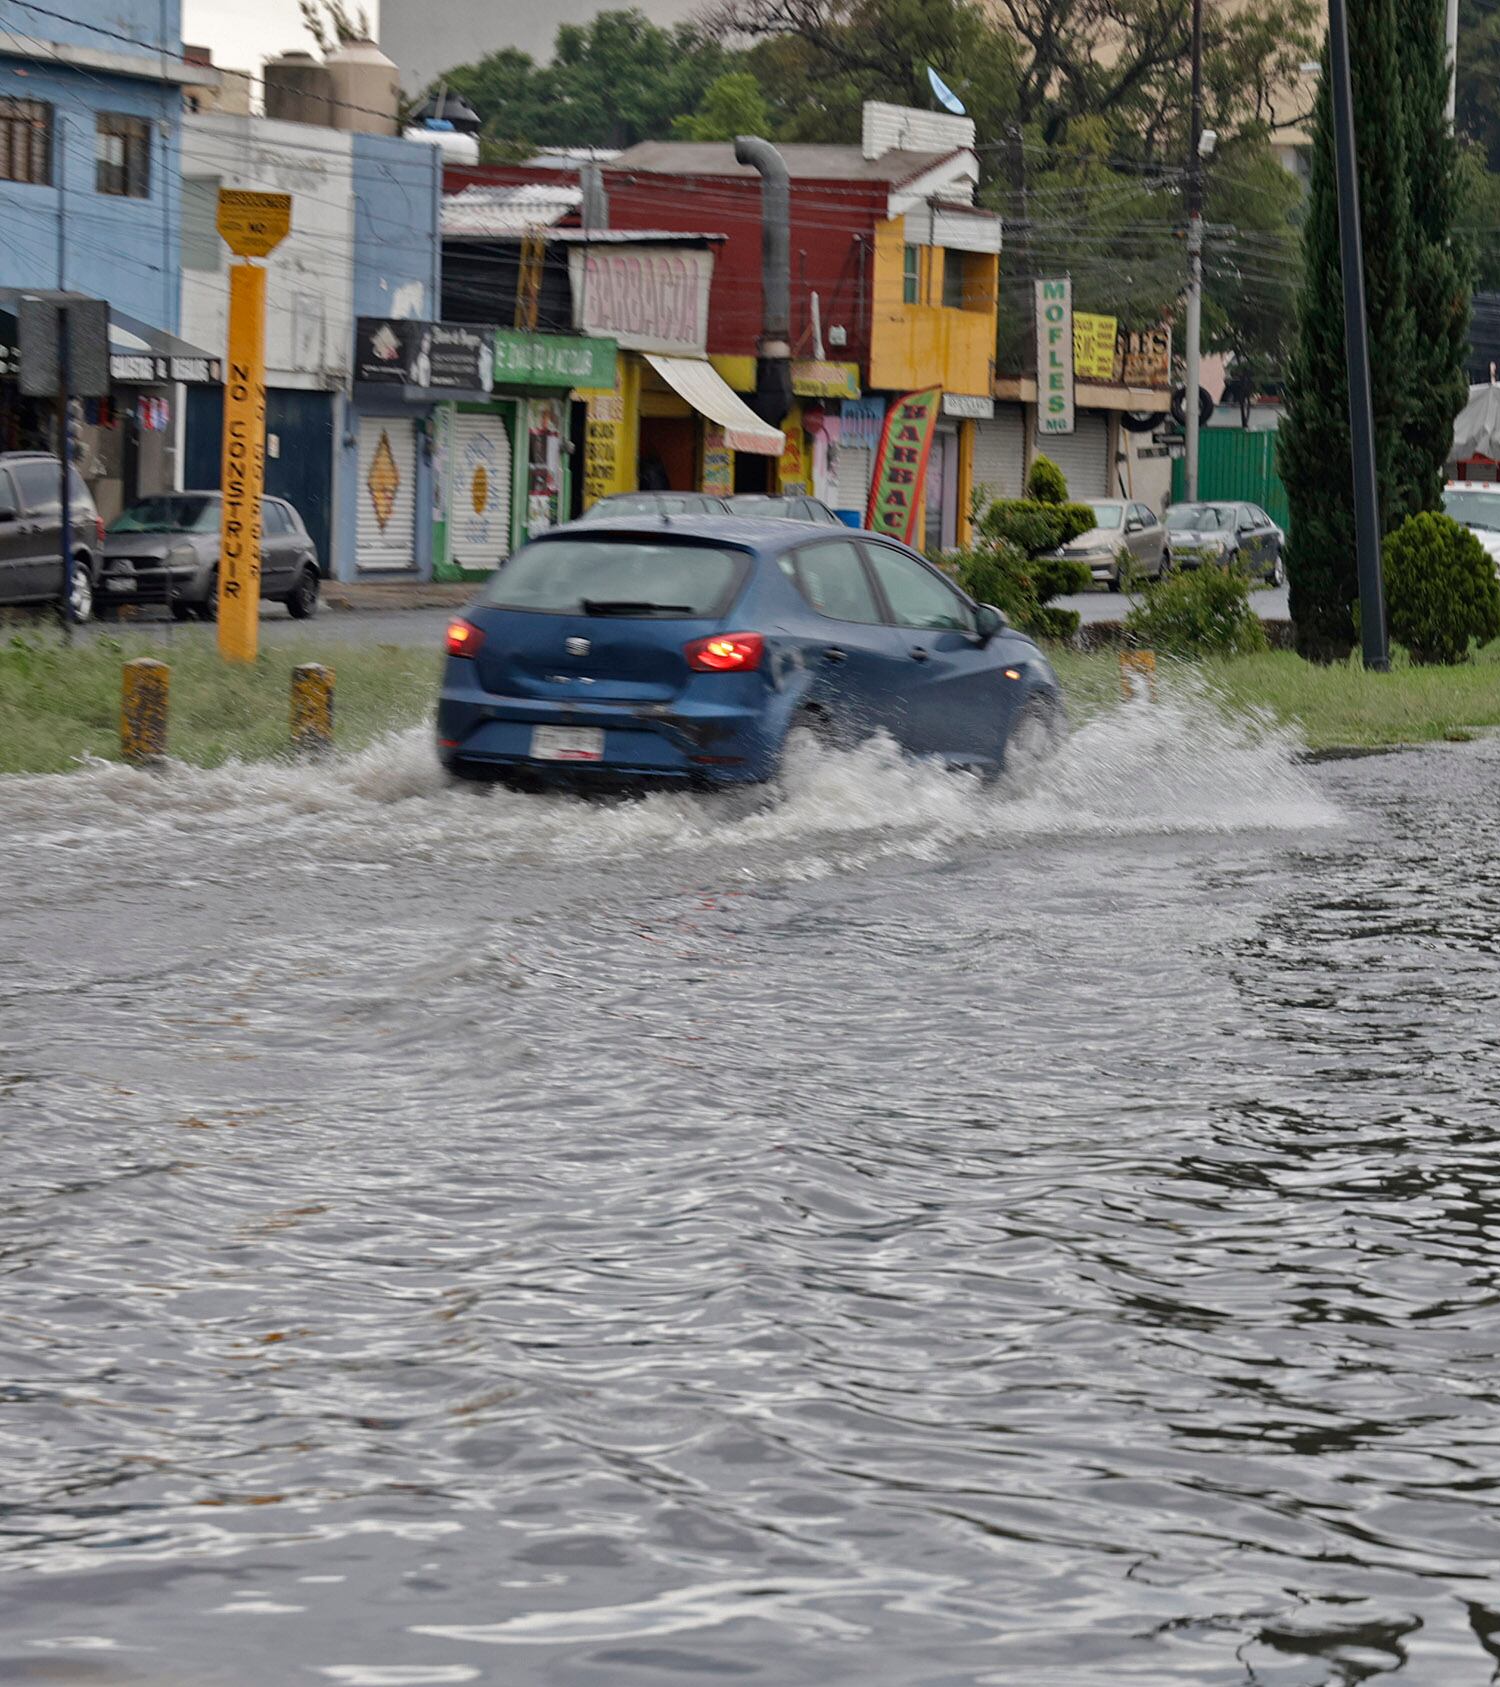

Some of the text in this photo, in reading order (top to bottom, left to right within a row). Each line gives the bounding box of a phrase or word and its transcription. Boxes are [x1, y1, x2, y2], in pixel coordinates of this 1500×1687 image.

[1043, 283, 1066, 413] MOFLES
[224, 363, 249, 599] NO CONSTRUIR
